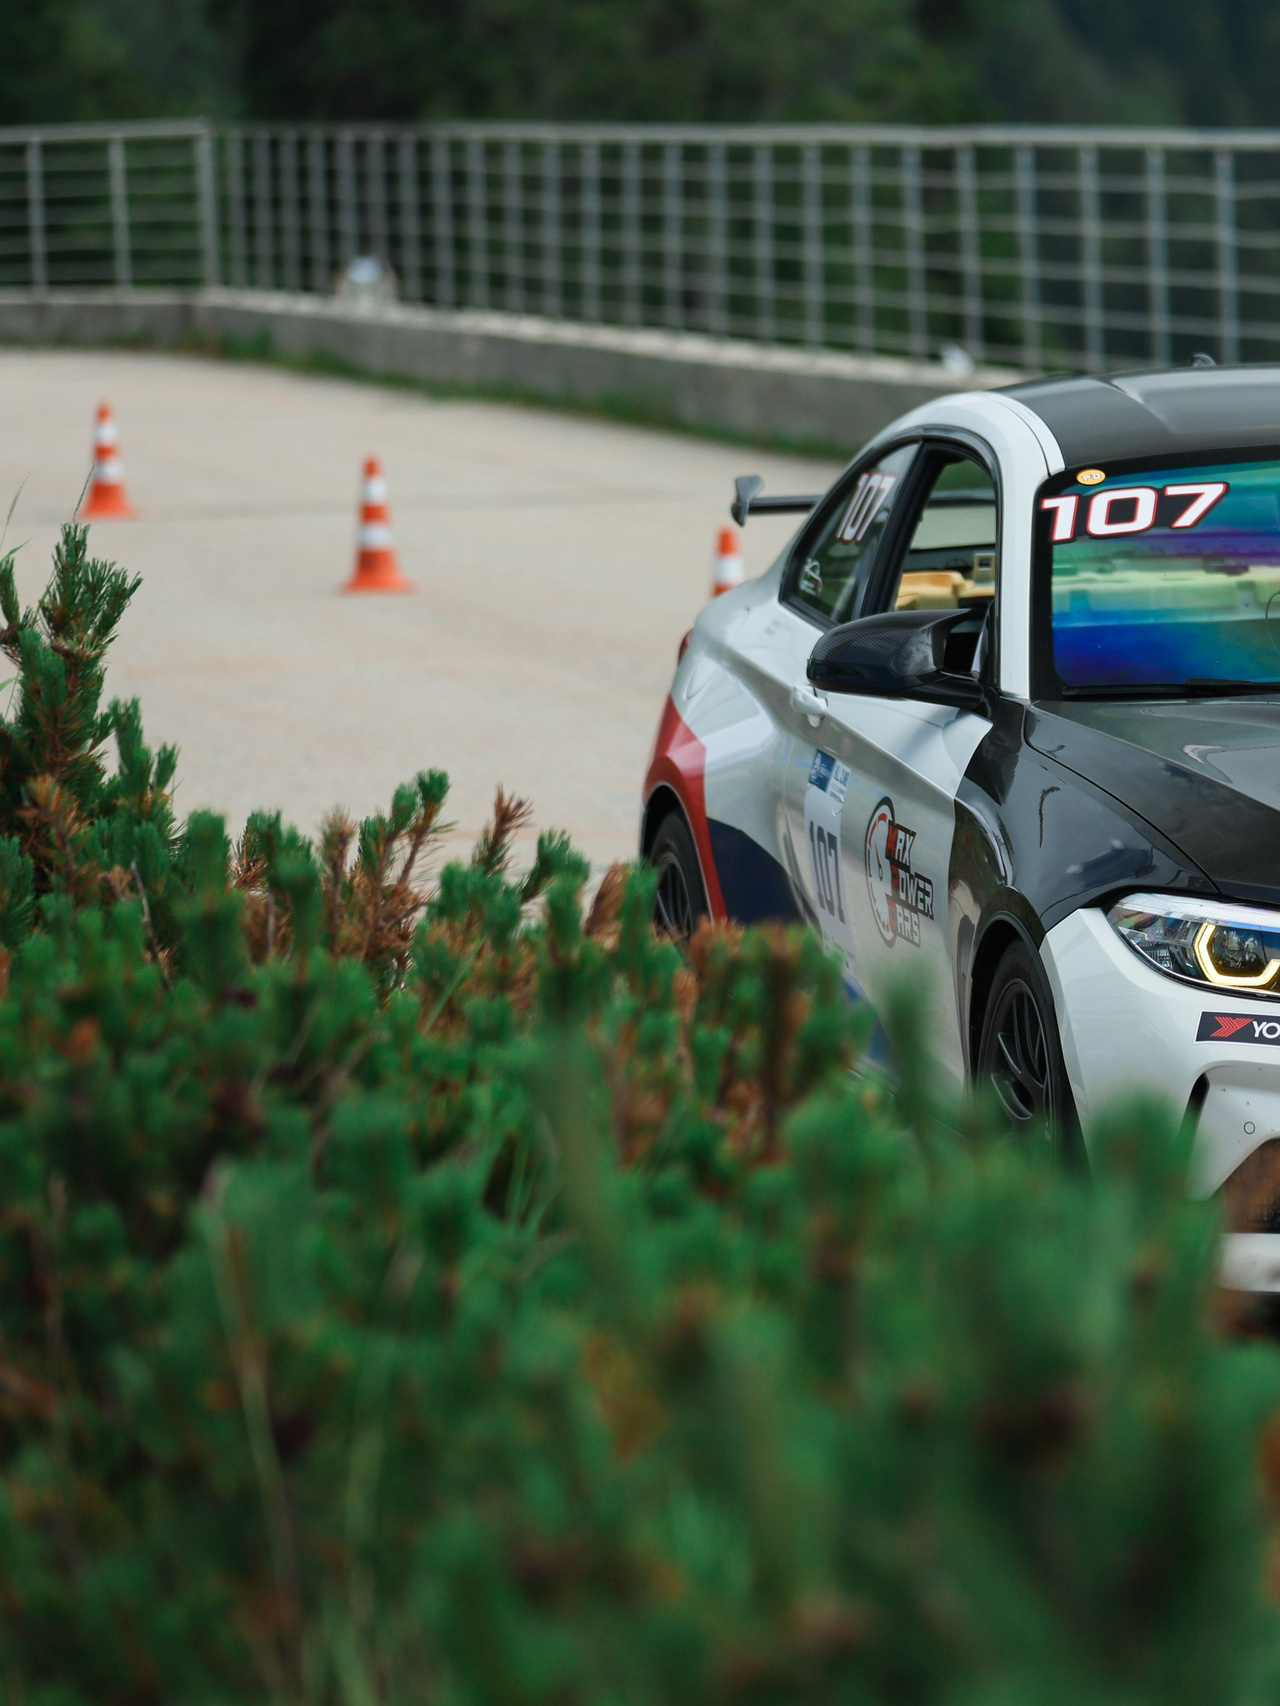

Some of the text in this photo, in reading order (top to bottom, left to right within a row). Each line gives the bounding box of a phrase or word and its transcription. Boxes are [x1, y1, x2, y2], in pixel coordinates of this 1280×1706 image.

[834, 471, 897, 543] 107
[1041, 481, 1229, 542] 107
[809, 820, 846, 925] 107
